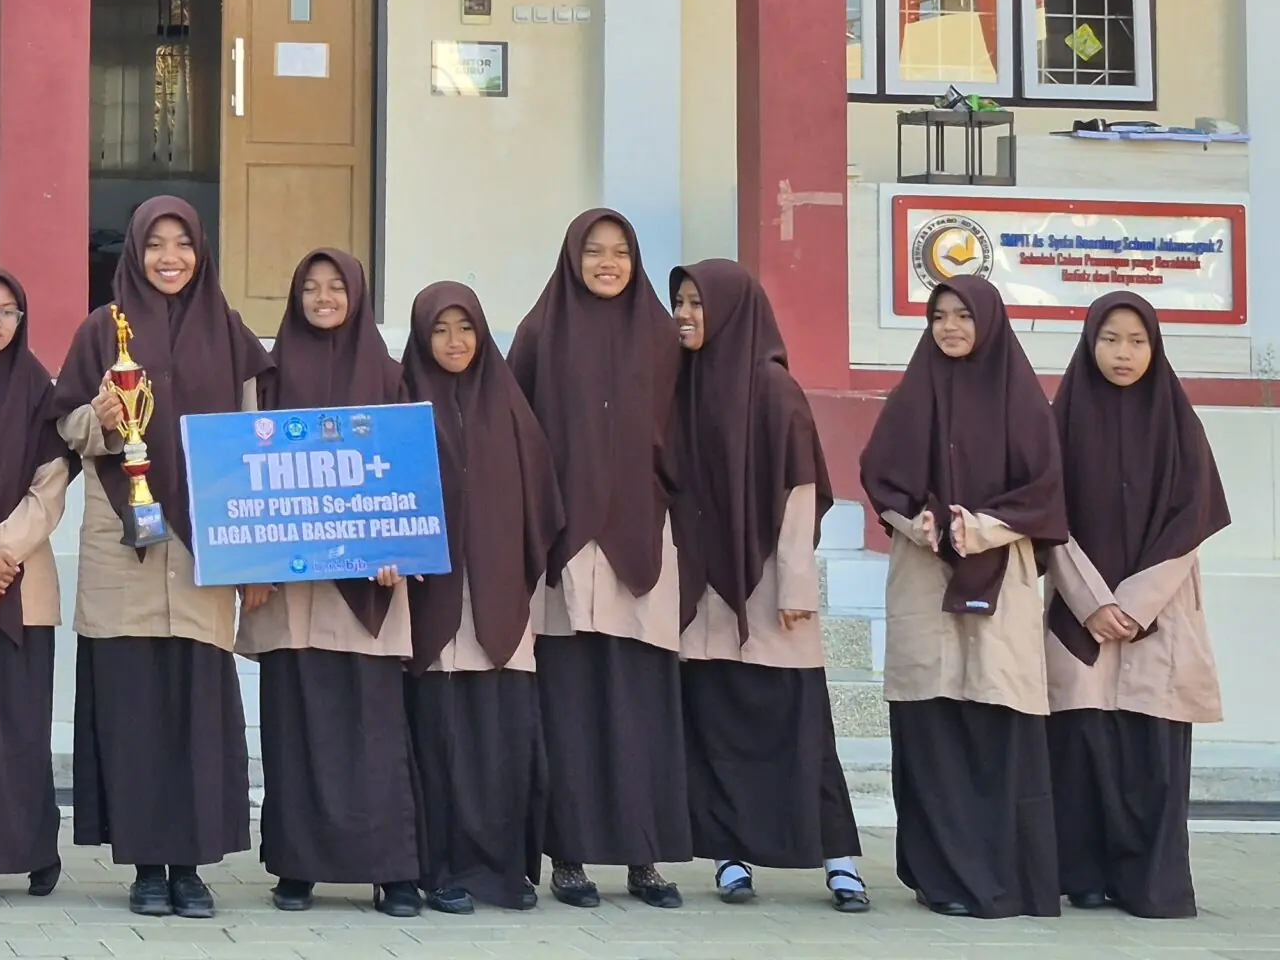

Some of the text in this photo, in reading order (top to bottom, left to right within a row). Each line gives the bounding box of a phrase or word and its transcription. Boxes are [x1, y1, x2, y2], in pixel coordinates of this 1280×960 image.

[1032, 234, 1045, 248] As
[1122, 236, 1156, 250] School
[1216, 239, 1224, 253] 2
[242, 449, 391, 491] THIRD+
[227, 492, 418, 519] SMP PUTRI Se-derajat
[208, 516, 441, 546] LAGA BOLA BASKET PELAJAR
